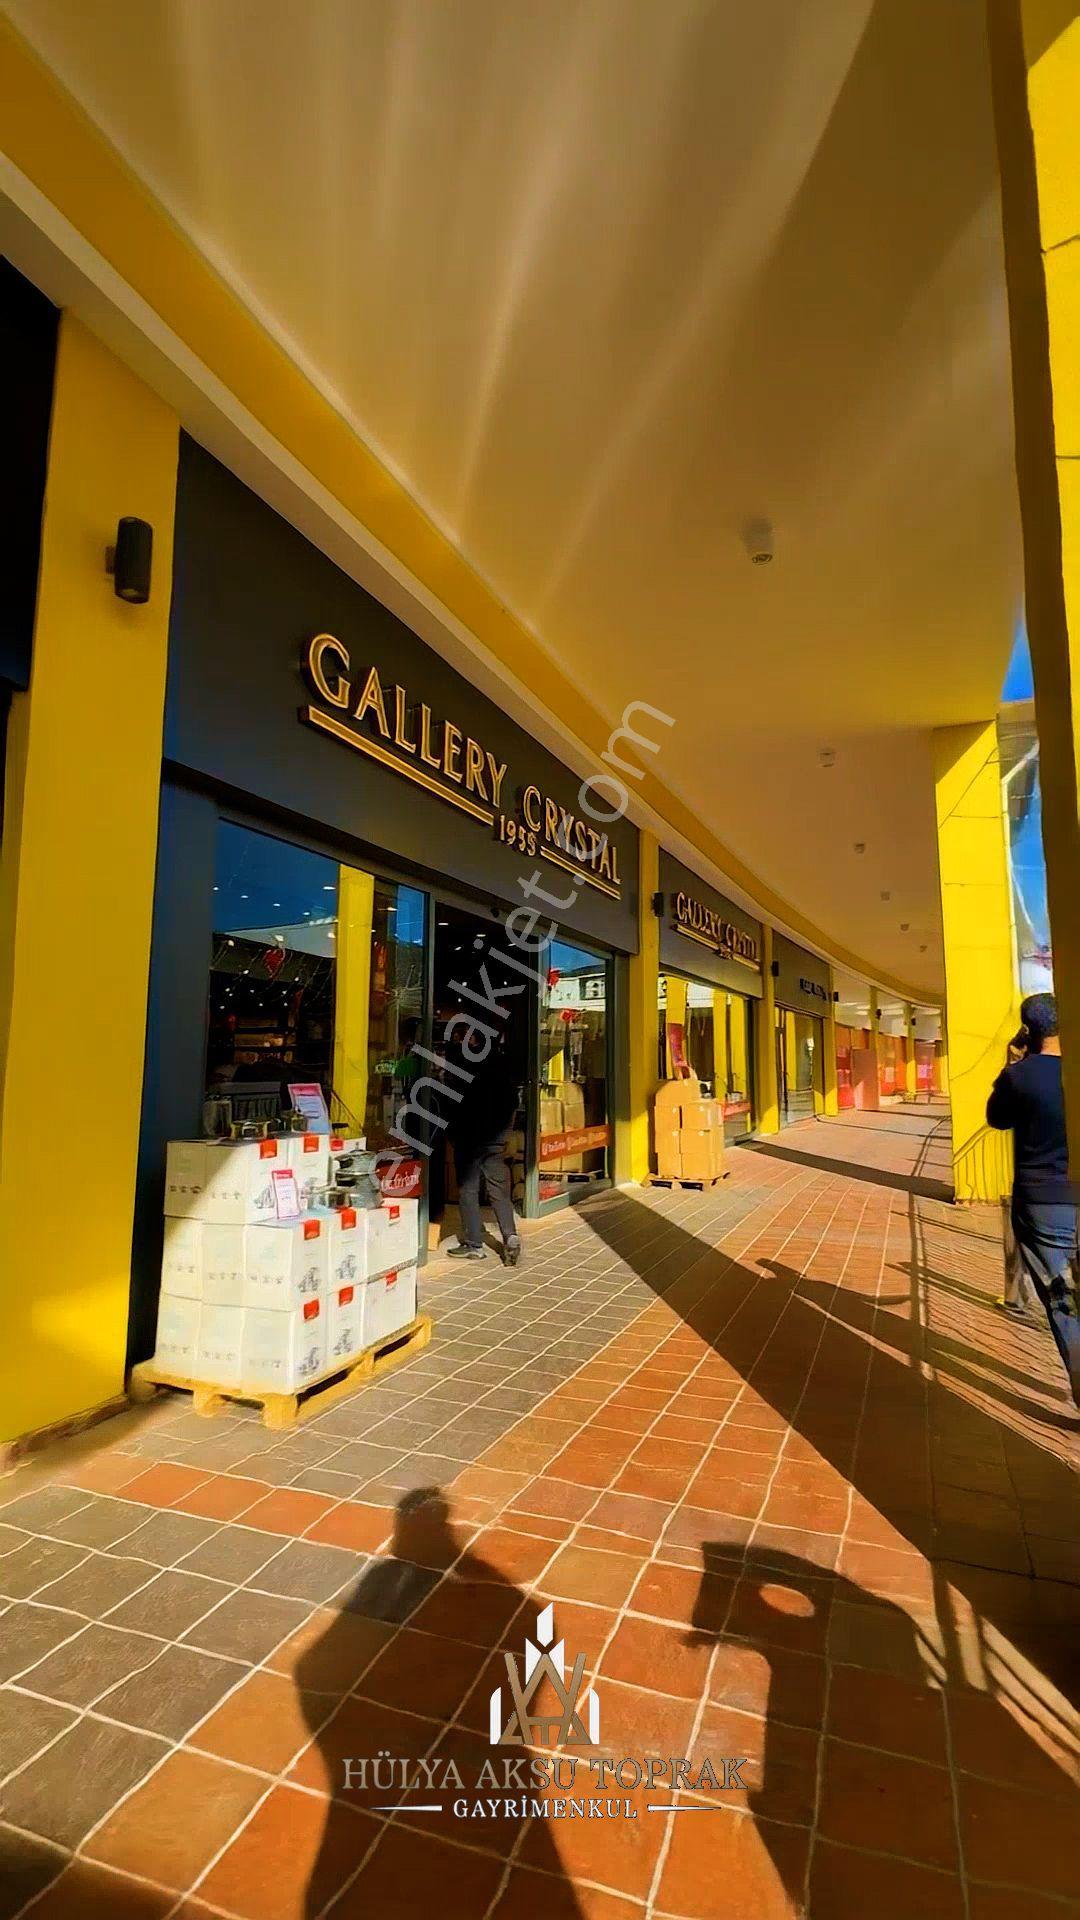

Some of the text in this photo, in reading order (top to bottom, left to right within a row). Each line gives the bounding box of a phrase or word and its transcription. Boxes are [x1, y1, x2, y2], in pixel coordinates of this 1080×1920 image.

[308, 633, 622, 884] GALLERY CRYSTAL
[500, 815, 536, 857] 1955
